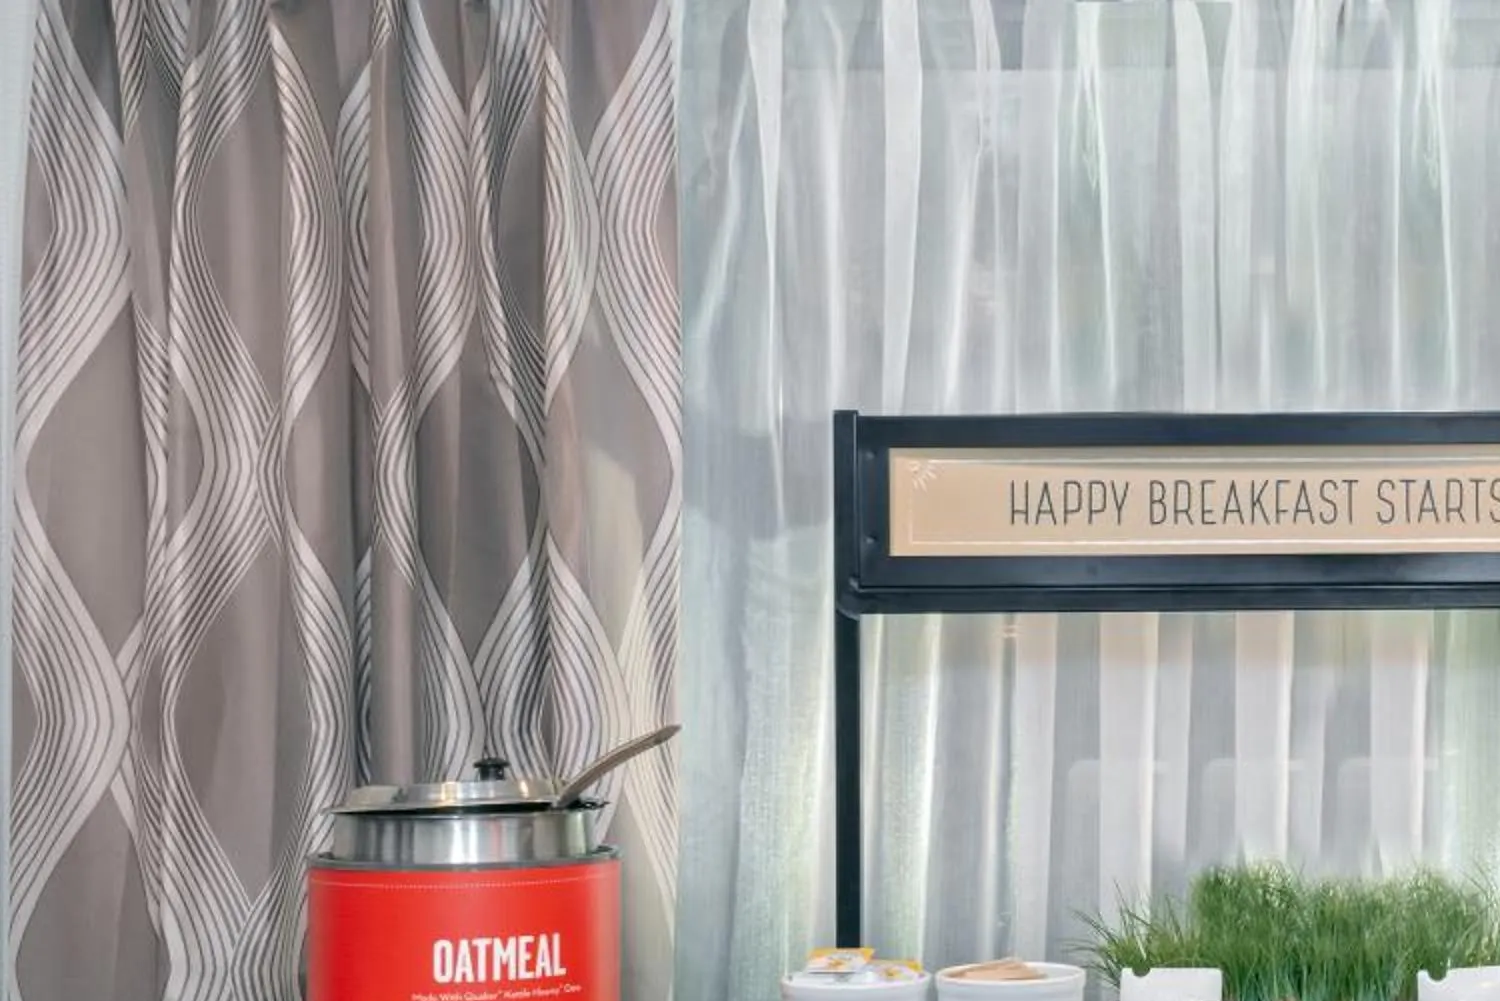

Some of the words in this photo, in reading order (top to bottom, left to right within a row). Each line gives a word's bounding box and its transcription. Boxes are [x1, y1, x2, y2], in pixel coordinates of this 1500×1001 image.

[1009, 479, 1129, 526] HAPPY
[1149, 478, 1359, 526] BREAKFAST
[432, 931, 567, 984] OATMEAL
